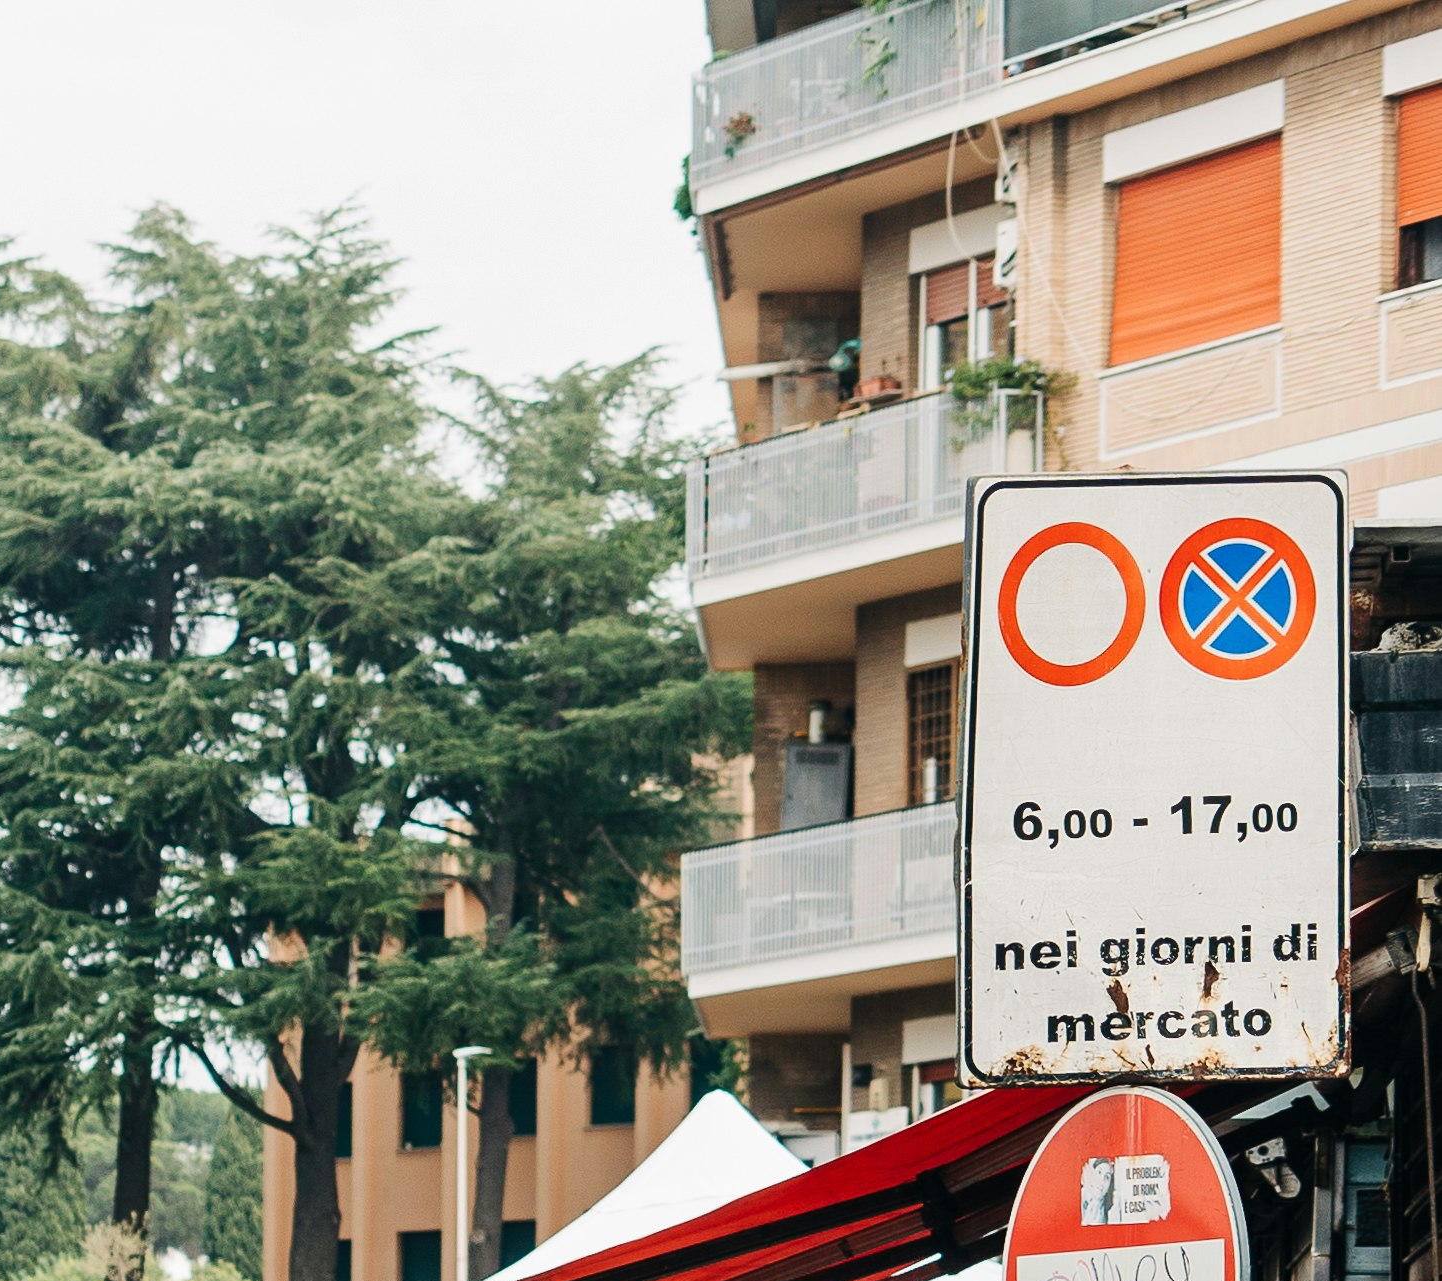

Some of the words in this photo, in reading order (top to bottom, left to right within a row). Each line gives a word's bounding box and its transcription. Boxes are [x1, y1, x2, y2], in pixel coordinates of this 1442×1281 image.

[1013, 801, 1113, 849] 6,00
[1170, 794, 1298, 843] 17,00
[994, 929, 1078, 971] nei
[1099, 924, 1252, 977] giorni
[1273, 922, 1318, 962] di
[1047, 1000, 1272, 1043] mercato
